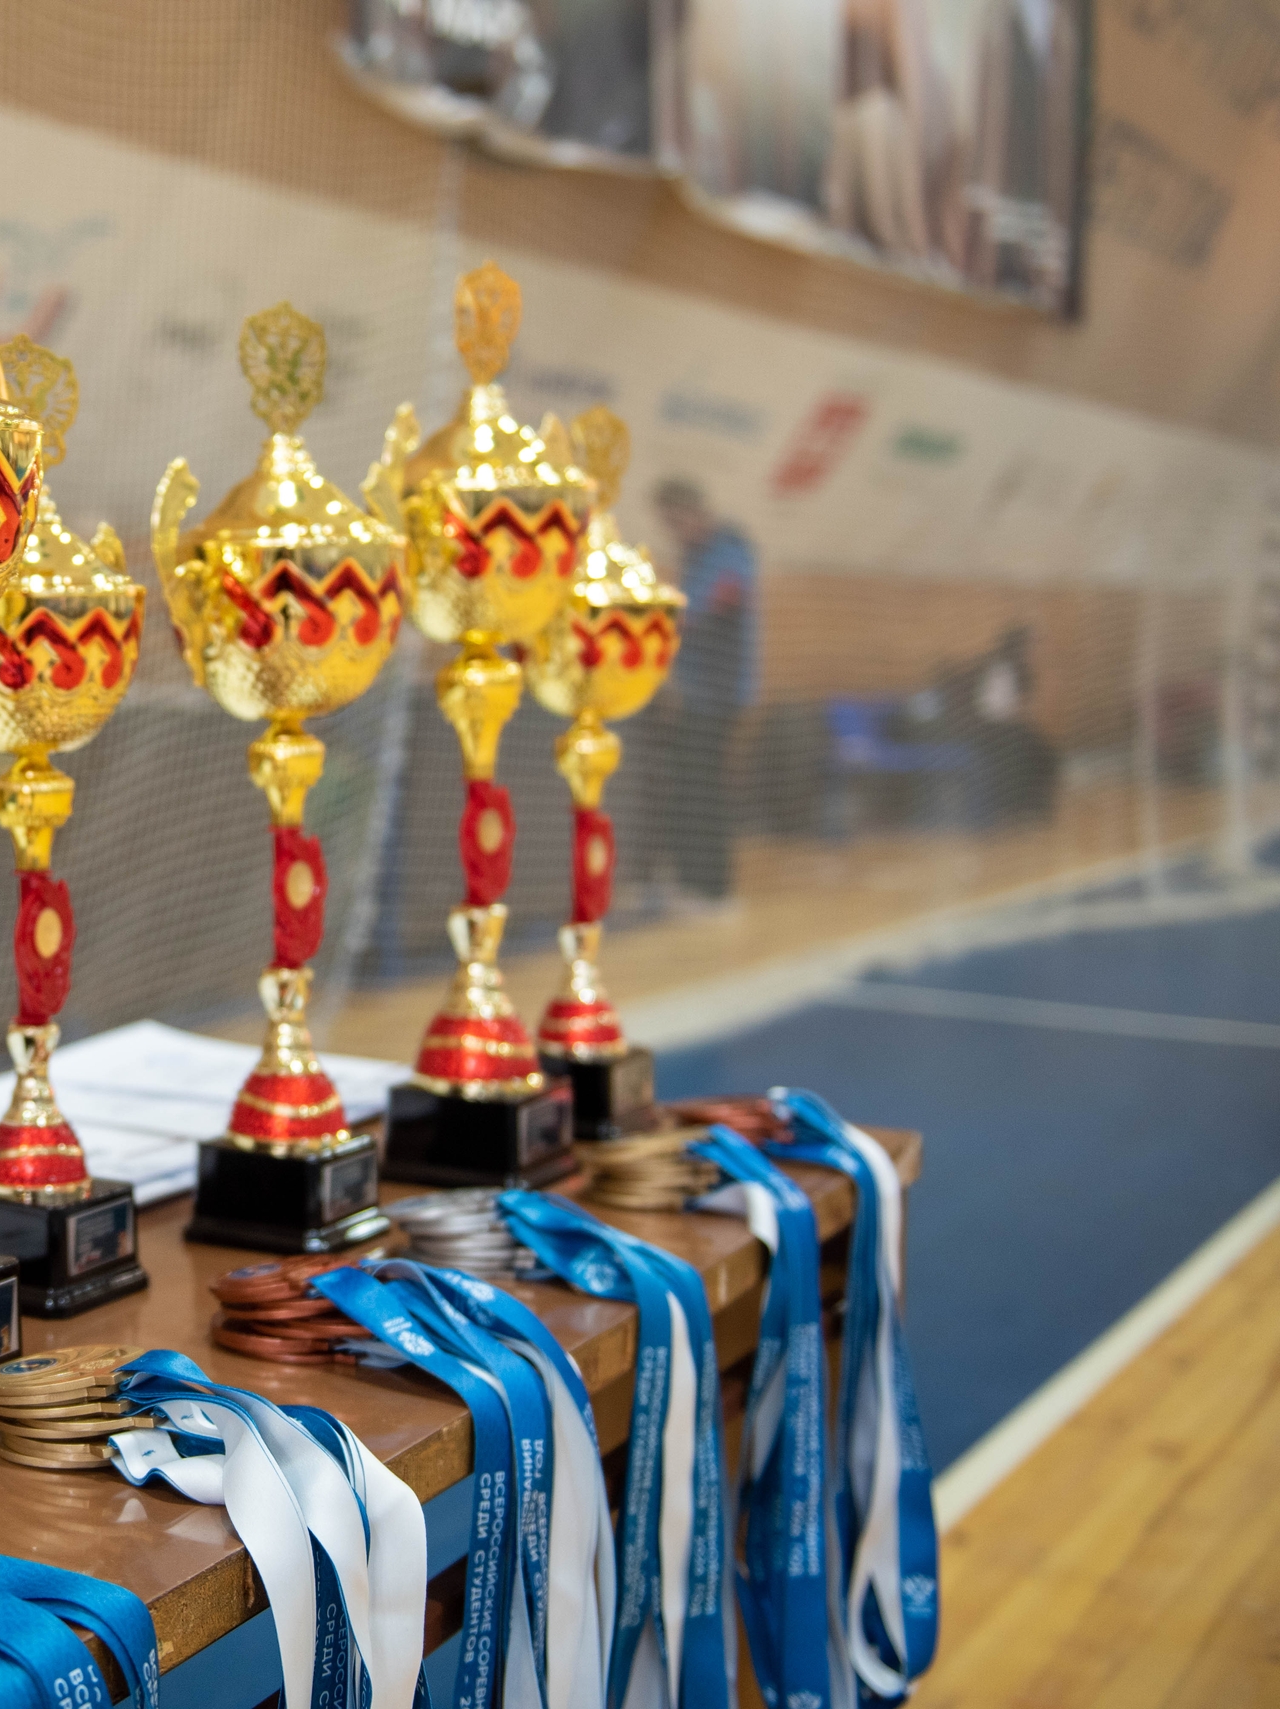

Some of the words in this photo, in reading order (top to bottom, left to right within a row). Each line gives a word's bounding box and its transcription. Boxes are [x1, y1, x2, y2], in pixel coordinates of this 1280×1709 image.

[476, 1472, 492, 1540] СРЕДИ
[481, 1470, 507, 1632] ВСЕРОССИЙСКИЕ
[321, 1602, 337, 1678] СРЕДИ
[464, 1549, 487, 1664] СТУДЕНТОВ
